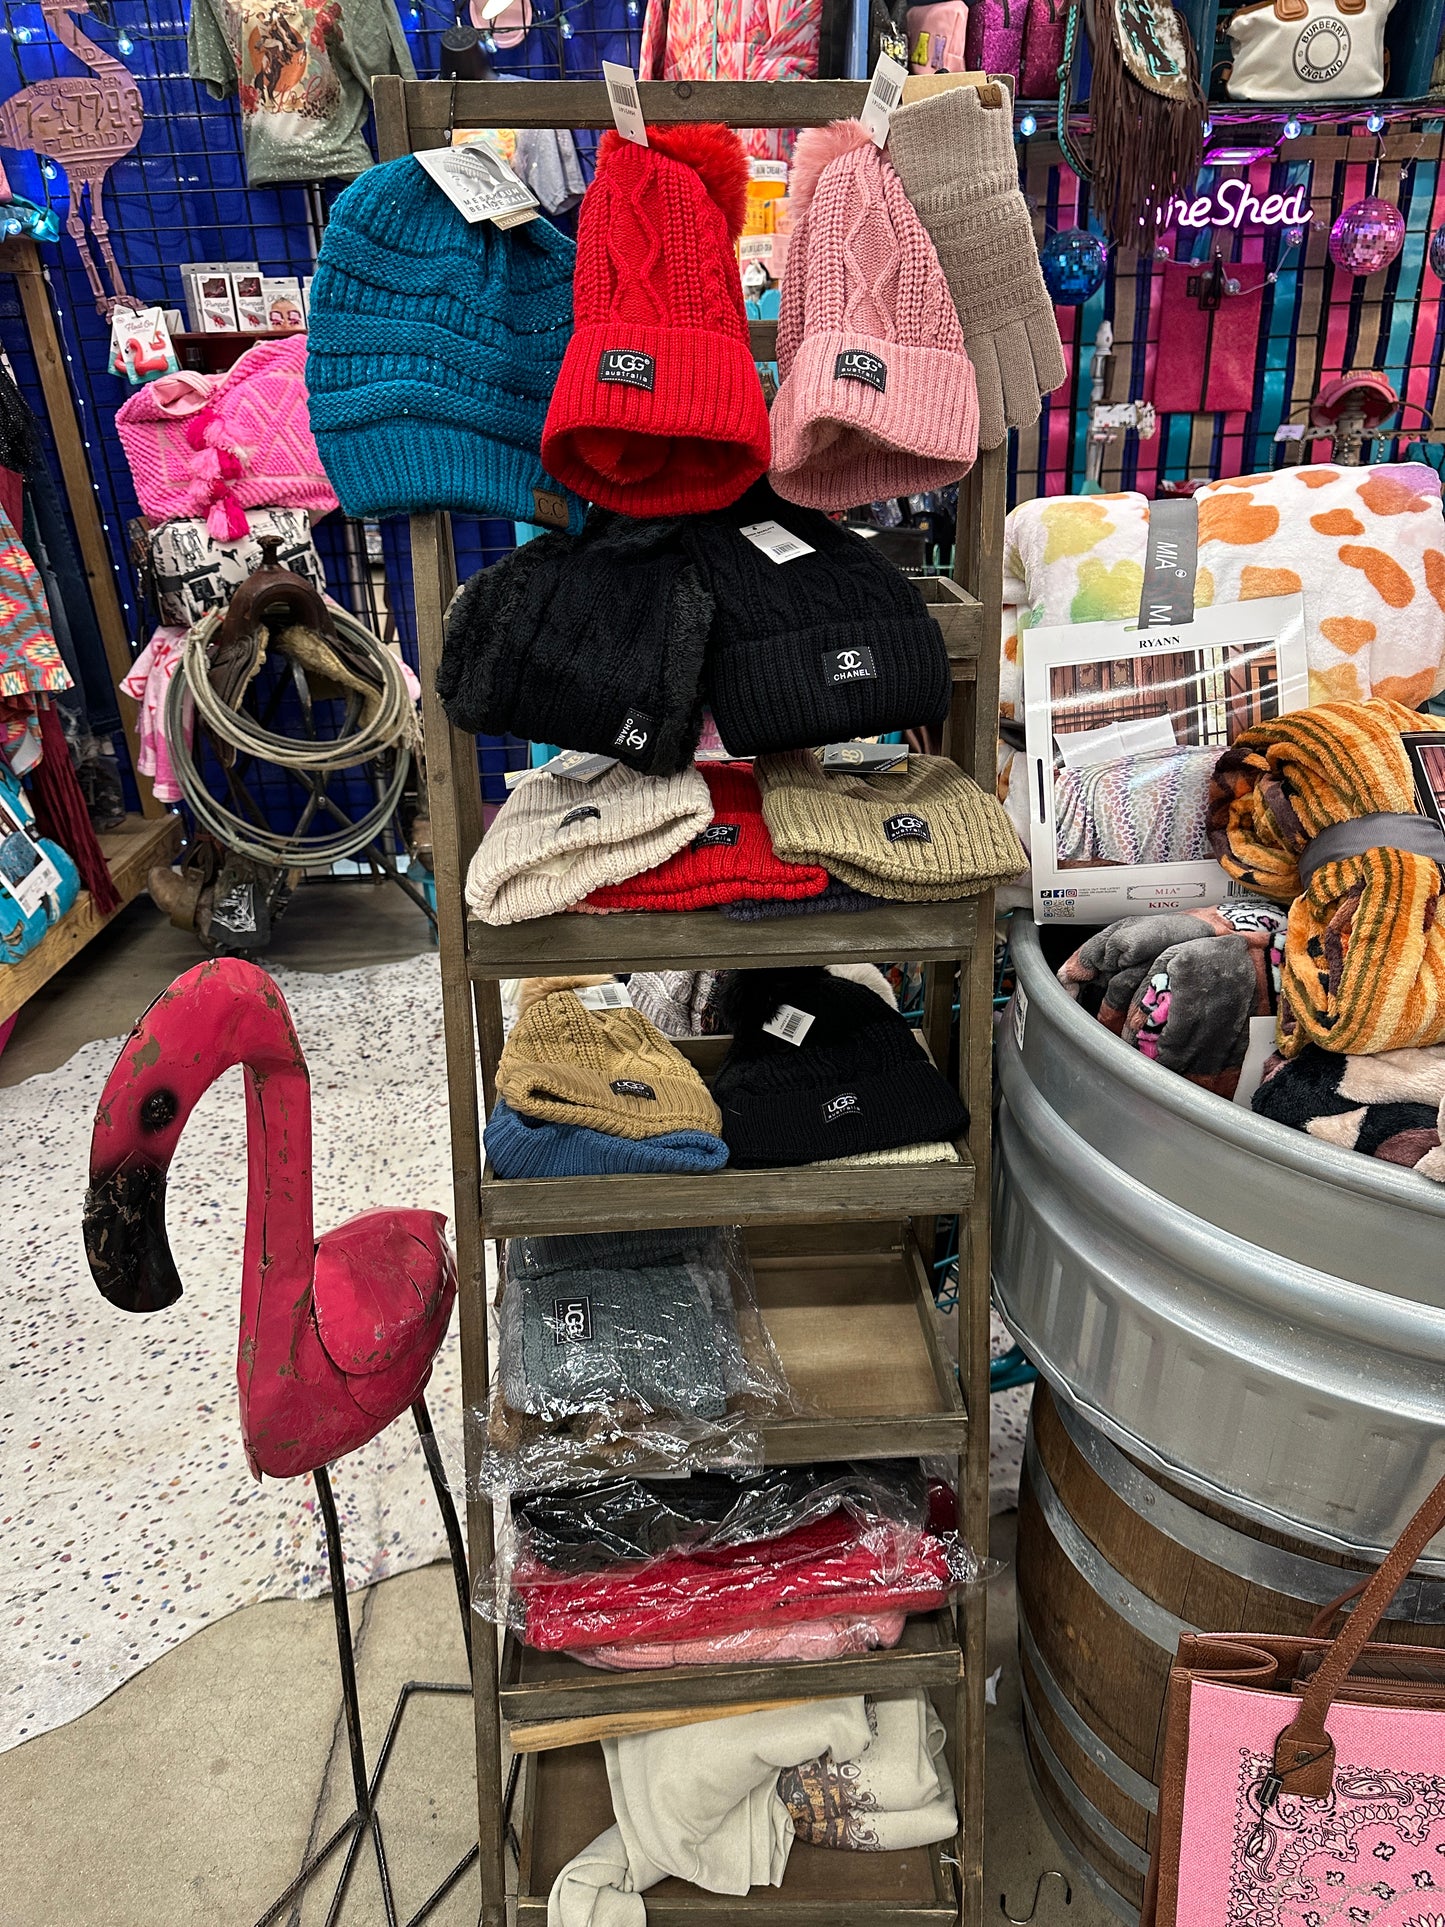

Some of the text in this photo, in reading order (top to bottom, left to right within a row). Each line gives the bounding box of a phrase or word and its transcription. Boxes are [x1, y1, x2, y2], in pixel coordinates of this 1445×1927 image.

[1301, 20, 1346, 43] BURBERRY
[1300, 60, 1343, 79] ENGLAND
[43, 130, 133, 152] FLORIDA
[500, 187, 520, 199] BUN
[605, 370, 648, 383] australia
[841, 367, 881, 383] australia
[1154, 541, 1179, 570] MIA
[1138, 635, 1181, 649] RYANN
[833, 668, 871, 681] CHANEL
[614, 718, 634, 746] CHANEL
[1148, 901, 1180, 909] KING
[828, 1105, 861, 1119] australia
